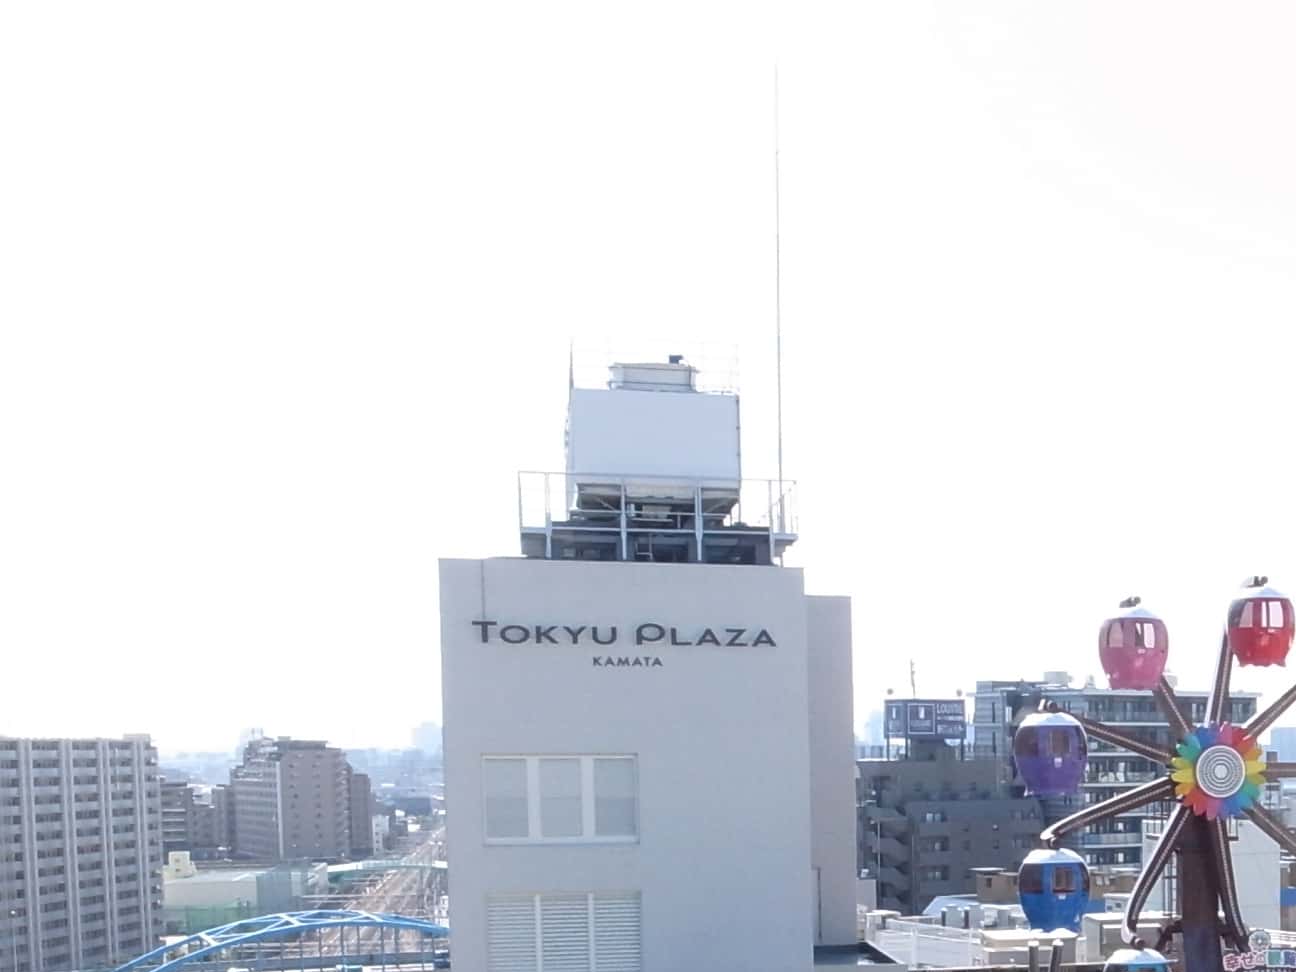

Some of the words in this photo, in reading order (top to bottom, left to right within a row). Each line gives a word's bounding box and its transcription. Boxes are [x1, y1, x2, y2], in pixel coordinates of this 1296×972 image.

[472, 620, 618, 646] TOKYU
[635, 623, 777, 648] PLAZA
[592, 656, 664, 668] KAMATA
